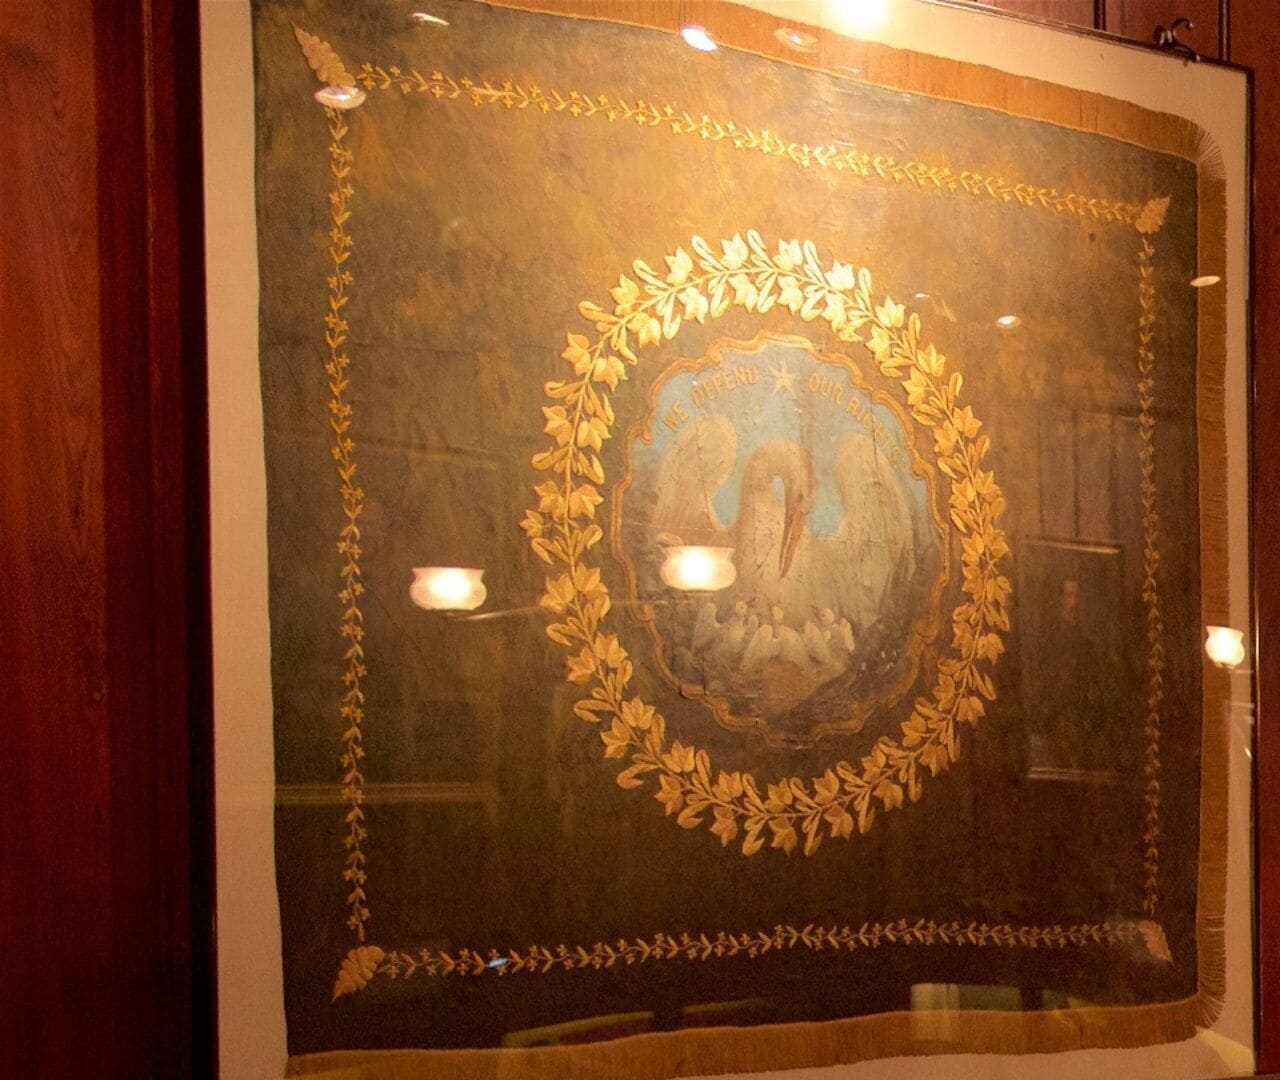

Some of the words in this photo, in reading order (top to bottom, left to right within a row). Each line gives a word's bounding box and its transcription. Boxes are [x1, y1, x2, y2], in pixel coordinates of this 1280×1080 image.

[663, 400, 690, 432] WE
[689, 364, 760, 407] DEFEND
[808, 372, 844, 405] OUR
